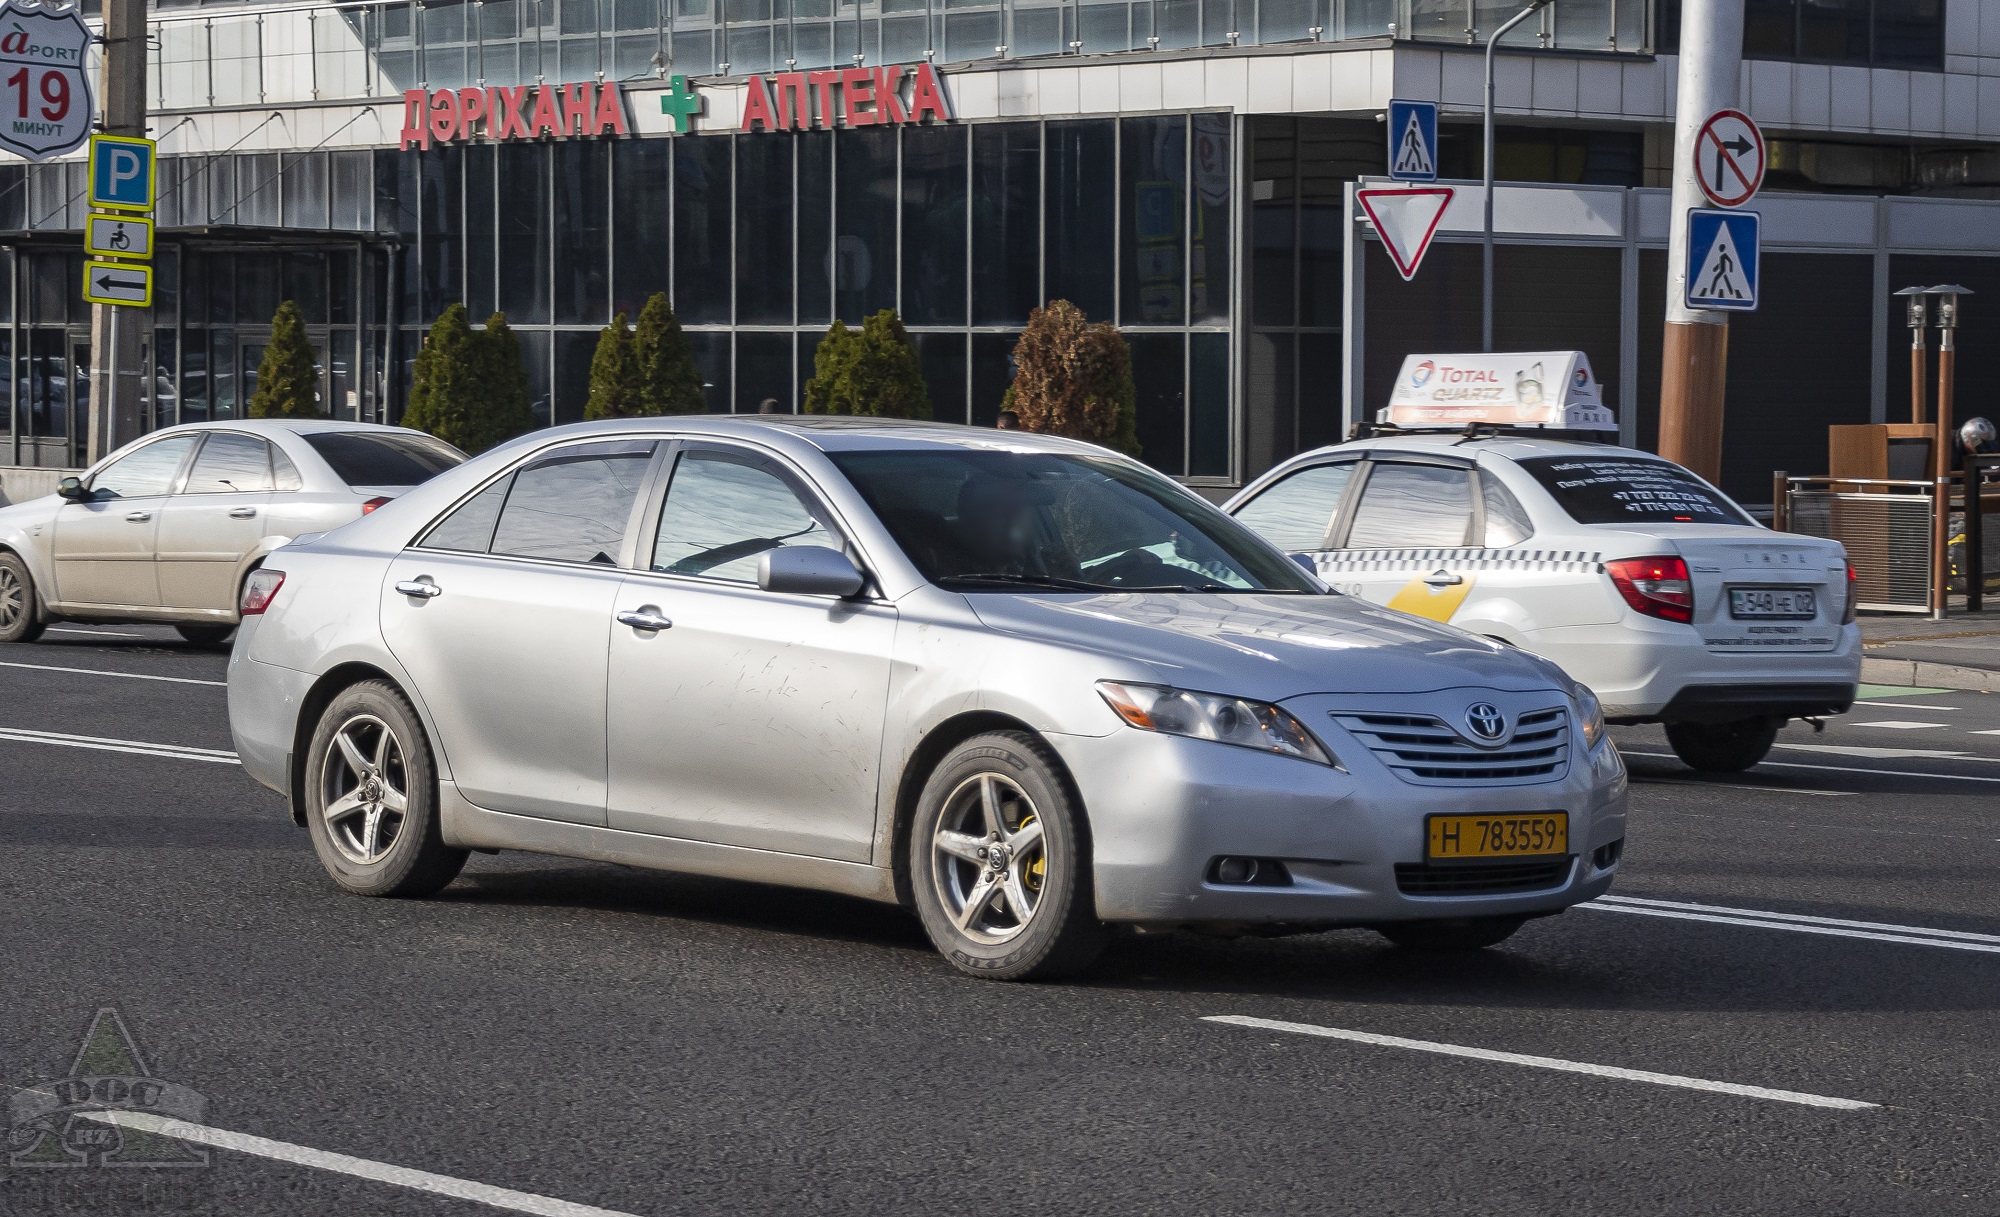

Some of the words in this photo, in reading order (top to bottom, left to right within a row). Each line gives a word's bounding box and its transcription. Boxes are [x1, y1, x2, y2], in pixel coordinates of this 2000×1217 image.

[7, 67, 71, 122] 19
[741, 63, 953, 132] АПТЕКА
[12, 120, 64, 137] МИНУТ
[400, 80, 629, 151] ДӘРІХАНА
[108, 148, 141, 196] P
[1432, 387, 1505, 402] QUARTZ
[1440, 367, 1500, 384] TOTAL
[1441, 821, 1461, 853] H
[1476, 818, 1557, 852] 783559
